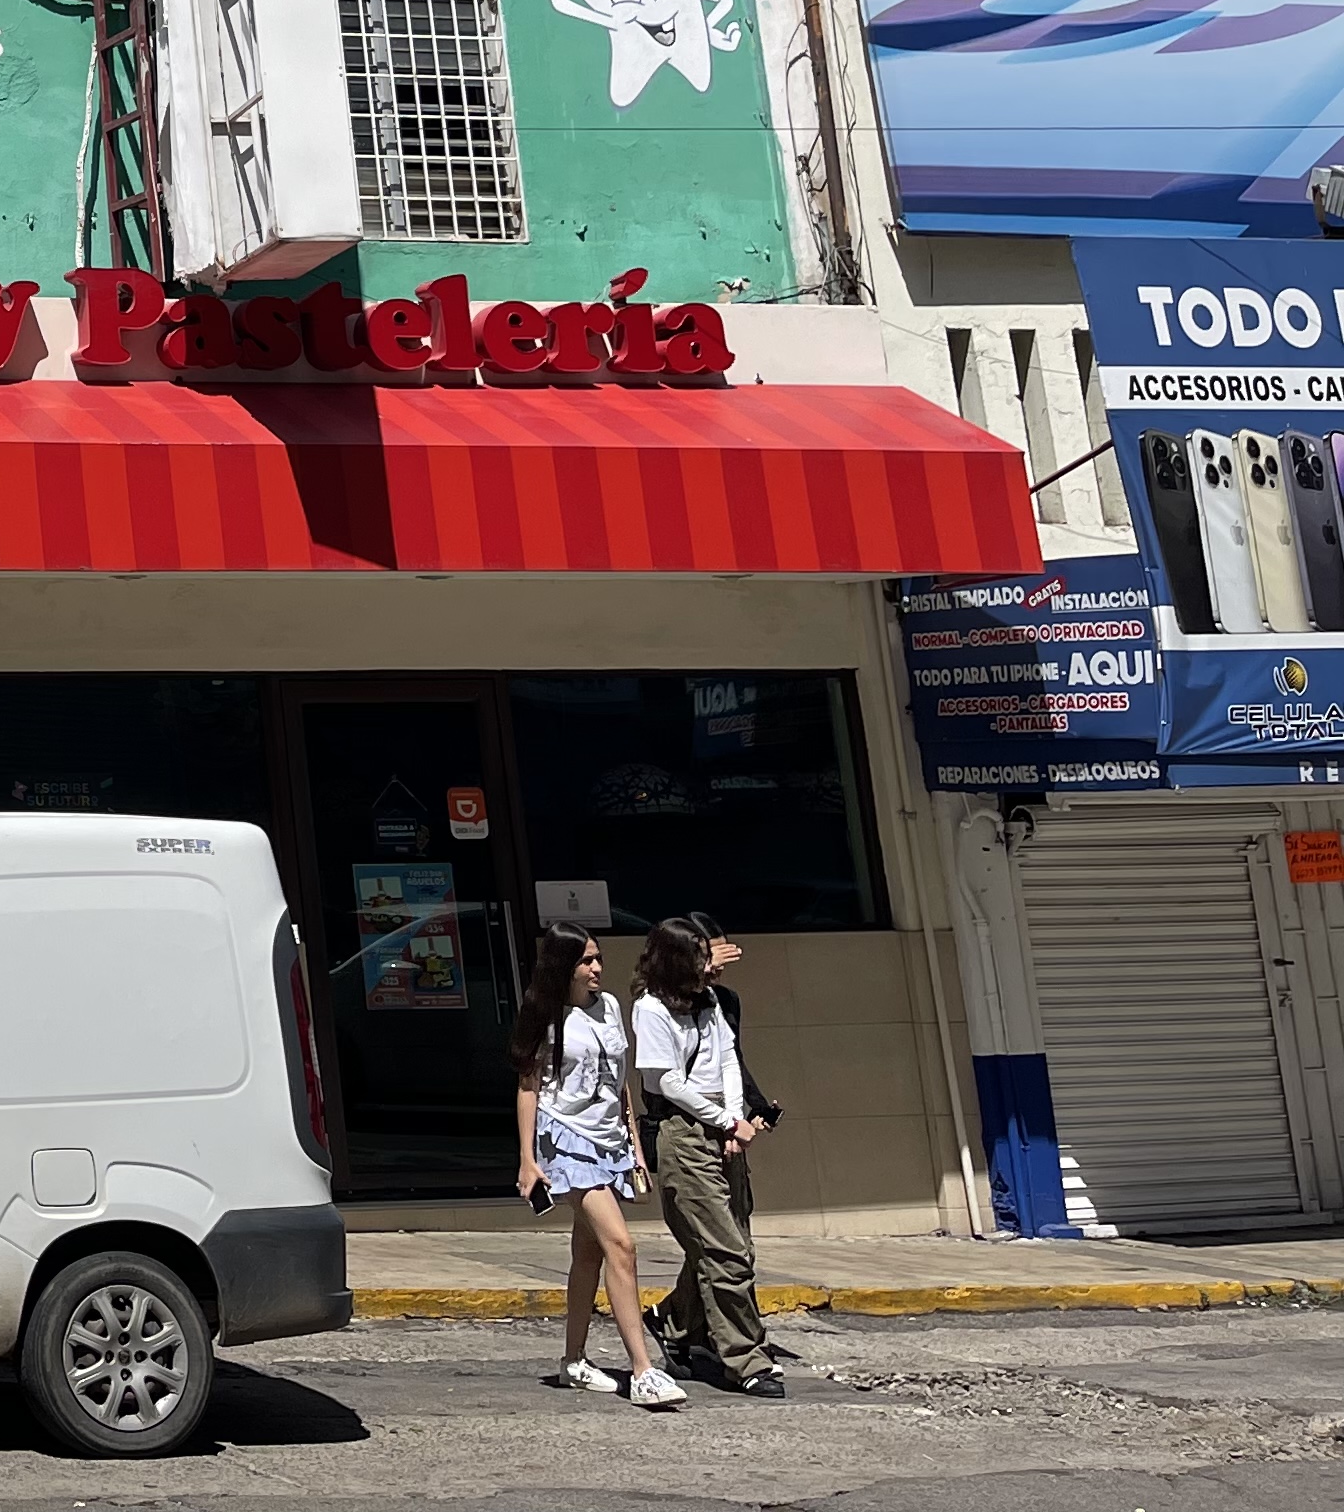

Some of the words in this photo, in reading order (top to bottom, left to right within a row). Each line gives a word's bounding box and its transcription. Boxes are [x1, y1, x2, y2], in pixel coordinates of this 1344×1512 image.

[64, 266, 736, 374] Pastelería
[1138, 285, 1322, 348] TODO
[1128, 374, 1286, 402] ACCESORIOS
[1307, 376, 1344, 402] CA
[902, 593, 948, 613] CRISTAL
[952, 586, 1024, 608] TEMPLADO
[1051, 588, 1148, 610] INSTALACIÓN
[1028, 580, 1062, 607] GRATIS
[913, 631, 962, 649] NORMAL
[969, 624, 1038, 646] COMPLETO
[1039, 624, 1050, 642] O
[1053, 620, 1144, 641] PRIVACIDAD
[914, 668, 951, 686] TODO
[954, 667, 989, 685] PARA
[991, 666, 1008, 682] TU
[1010, 662, 1059, 681] IPHONE
[1067, 650, 1154, 686] AQUI
[938, 695, 1020, 715] ACCESORIOS
[1028, 692, 1129, 711] CARGADORES
[998, 714, 1068, 733] PANTALLAS
[1252, 722, 1344, 741] TOTAL
[937, 765, 1039, 784] REPARACIONES
[1048, 760, 1160, 783] DESBLOQUEOS
[34, 782, 90, 794] ESCRIBE
[27, 795, 45, 807] SU
[136, 837, 211, 848] SUPER
